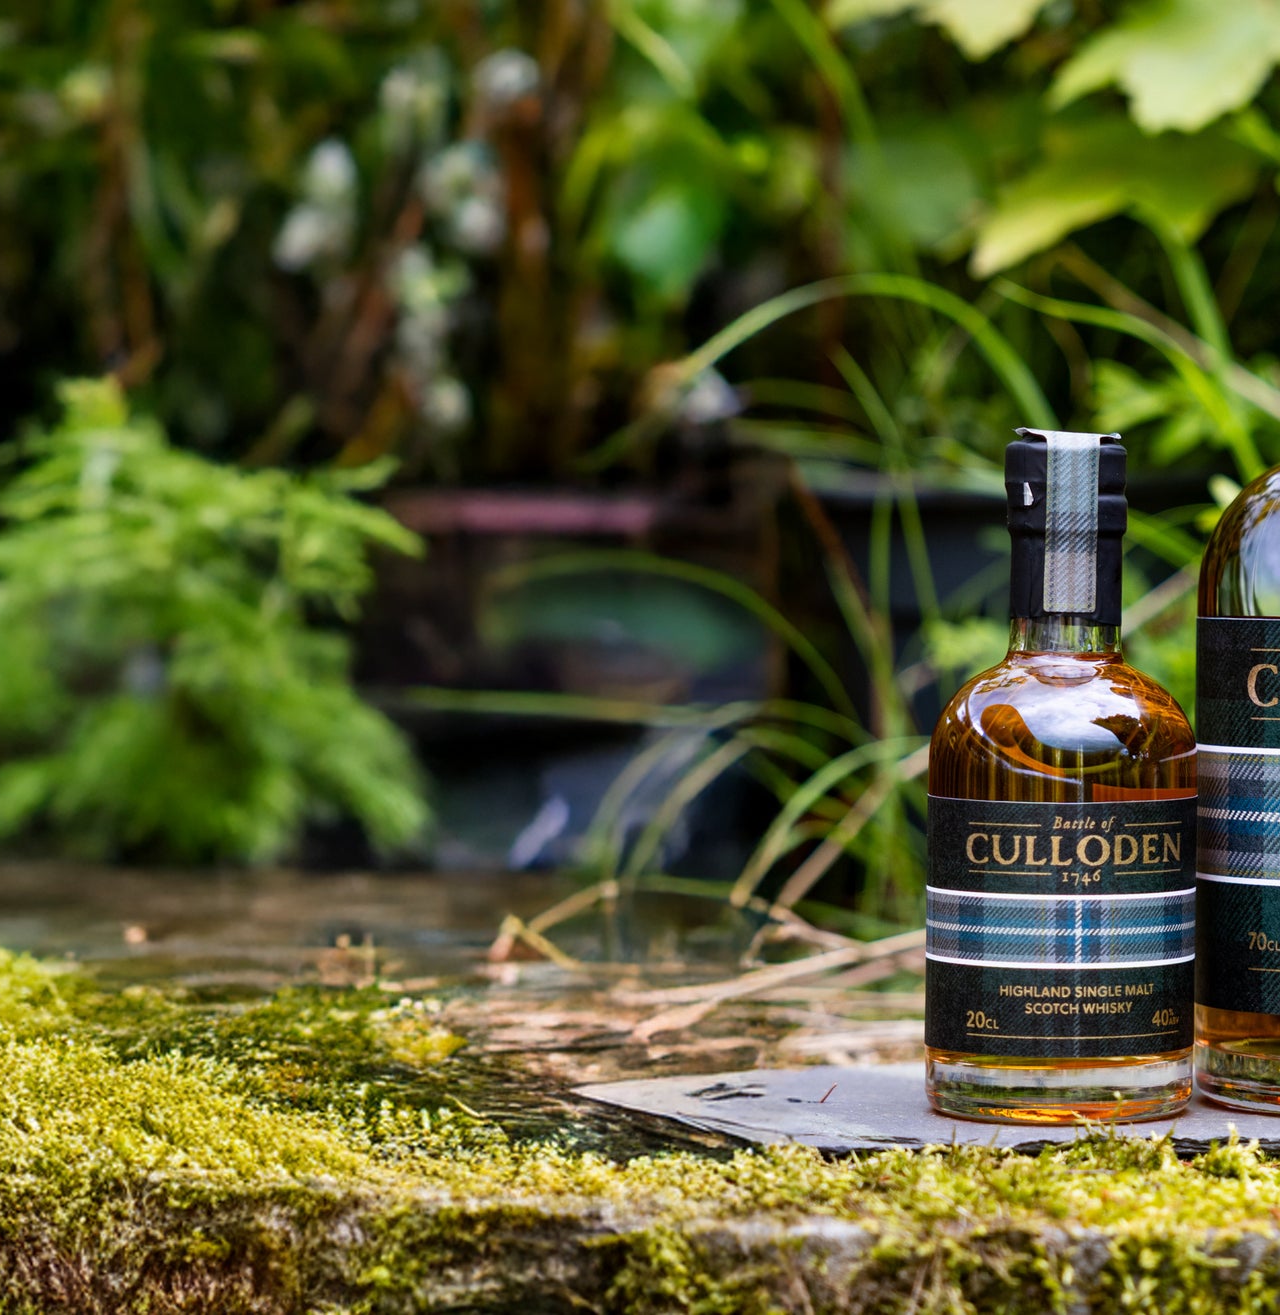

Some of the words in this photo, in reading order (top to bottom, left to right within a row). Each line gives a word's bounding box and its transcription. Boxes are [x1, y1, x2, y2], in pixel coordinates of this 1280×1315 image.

[1053, 816, 1096, 829] Battle
[1101, 816, 1116, 833] of
[966, 832, 1181, 866] CULLODEN
[1062, 869, 1101, 886] 1746
[1000, 985, 1071, 998] HIGHLAND
[1074, 985, 1122, 998] SINGLE
[1125, 983, 1155, 997] MALT
[1024, 1003, 1079, 1015] SCOTCH
[1082, 1001, 1133, 1014] WHISKY
